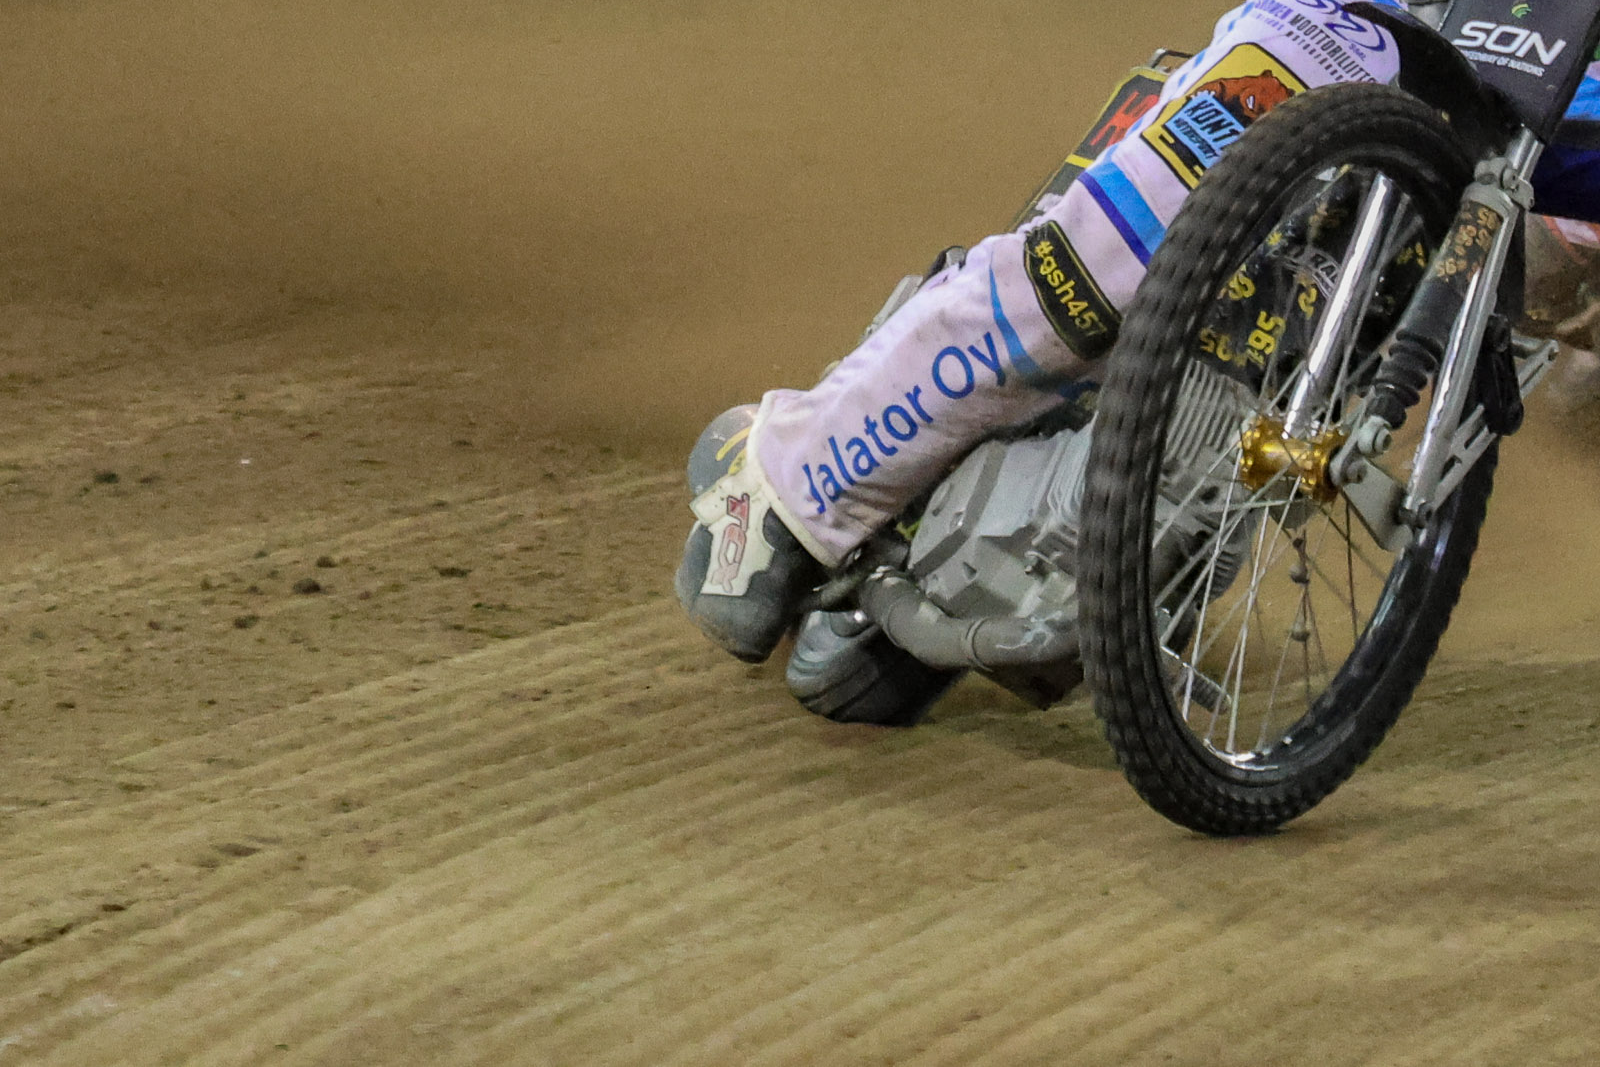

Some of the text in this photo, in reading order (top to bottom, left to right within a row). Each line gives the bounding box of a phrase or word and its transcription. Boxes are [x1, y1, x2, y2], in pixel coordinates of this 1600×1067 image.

[1451, 20, 1566, 65] SON
[802, 331, 1006, 514] Jalator Oy
